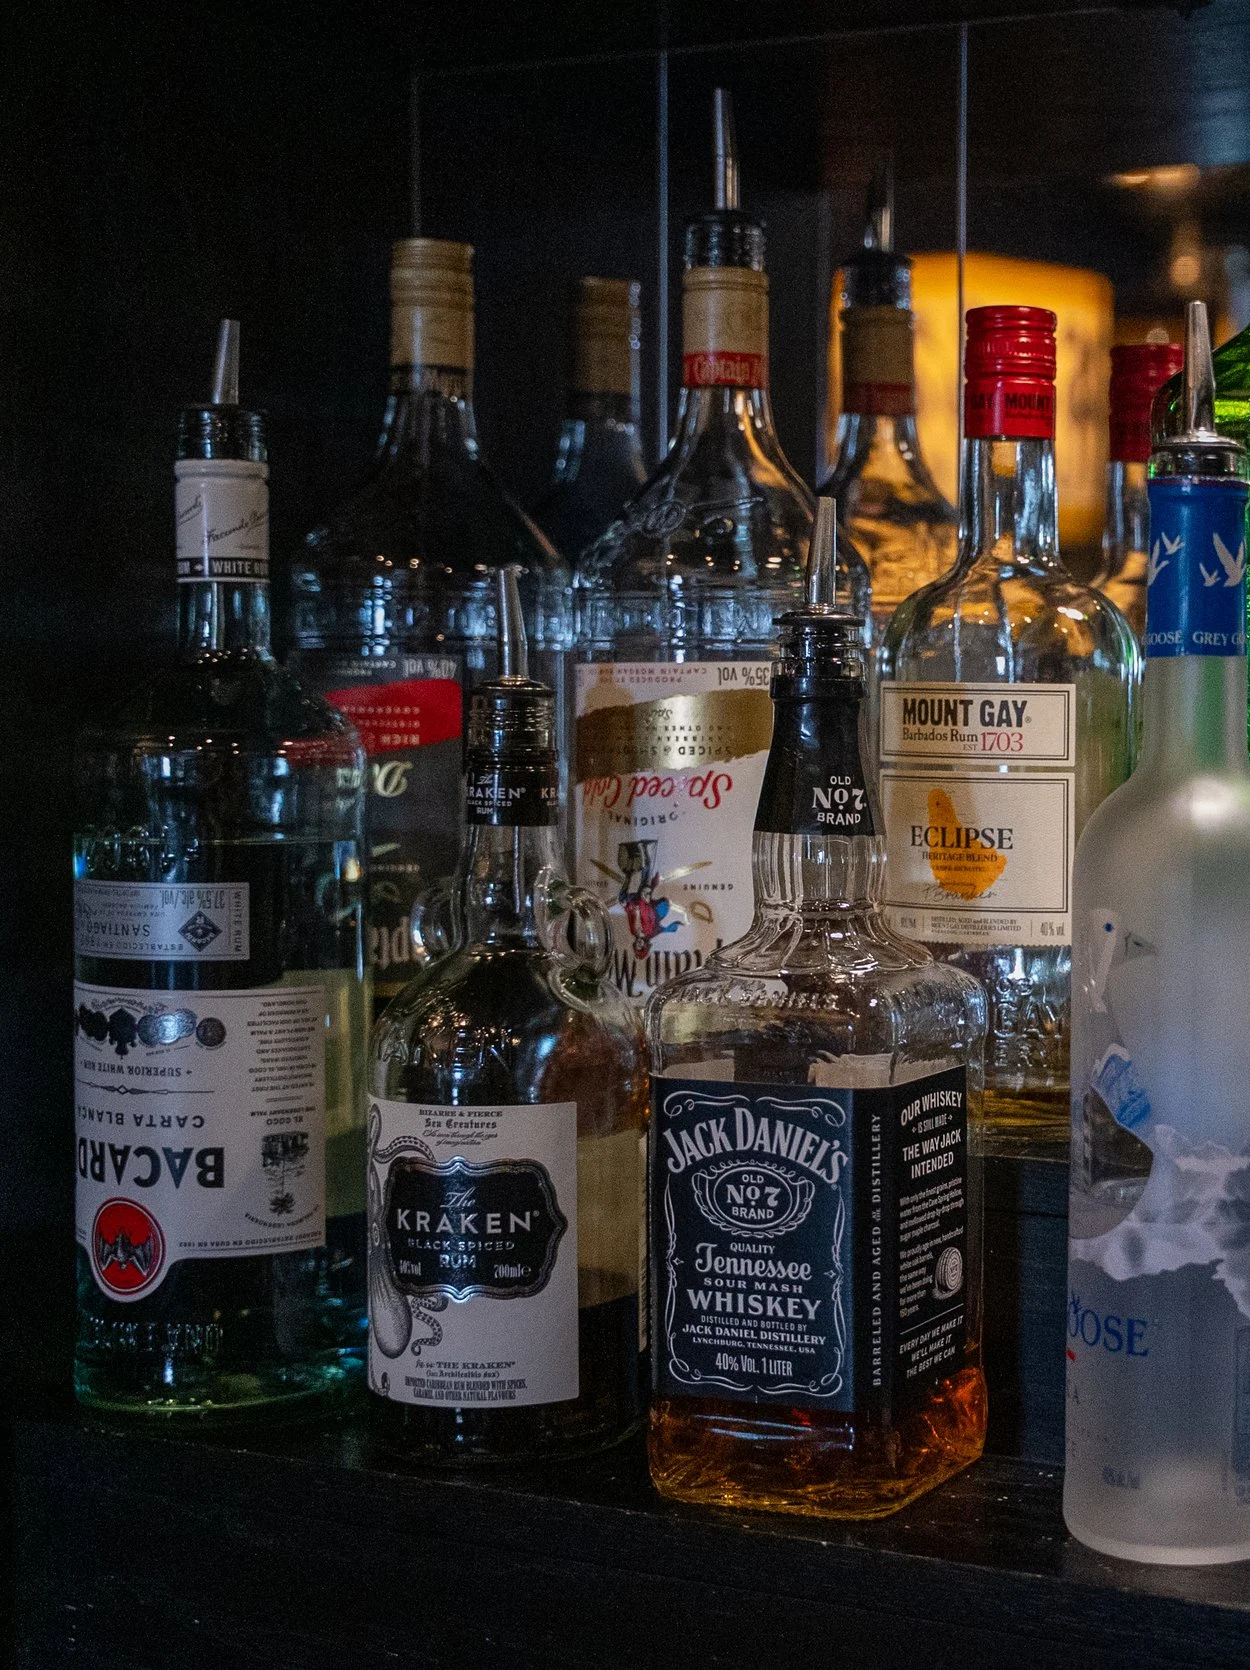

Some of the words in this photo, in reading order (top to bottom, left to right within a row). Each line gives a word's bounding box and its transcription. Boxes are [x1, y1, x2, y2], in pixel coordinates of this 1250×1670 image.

[211, 560, 251, 574] WHITE
[1192, 631, 1229, 647] GREY
[717, 667, 738, 686] vol
[742, 667, 770, 686] 35%
[902, 698, 973, 727] MOUNT
[980, 699, 1028, 728] GAY
[902, 727, 948, 742] Barbados
[950, 728, 978, 742] Rum
[980, 731, 1024, 752] 1703
[626, 770, 733, 810] Spiced
[830, 775, 851, 786] OLD
[468, 786, 520, 799] RAKEN
[476, 807, 493, 815] RUM
[817, 812, 861, 826] BRAND
[910, 825, 1014, 850] ECLIPSE
[683, 883, 734, 891] GENUINE
[97, 1061, 125, 1075] WHITE
[128, 1065, 182, 1077] SUPERIOR
[77, 1106, 124, 1126] BLANC
[133, 1113, 205, 1128] CARTA
[419, 1108, 457, 1117] BIZARRE
[467, 1110, 503, 1118] FIERCE
[900, 1099, 921, 1126] OUR
[921, 1090, 962, 1112] WHISKEY
[266, 1117, 291, 1126] COCO
[446, 1118, 497, 1129] Creatures
[663, 1117, 734, 1174] JACK
[733, 1107, 849, 1184] DANIEL'S
[902, 1143, 920, 1162] THE
[921, 1136, 940, 1155] WAY
[940, 1128, 961, 1149] JACK
[78, 1137, 225, 1189] BACARD
[871, 1114, 881, 1203] DISTILLERY
[911, 1151, 954, 1179] INTENDED
[742, 1173, 764, 1183] OLD
[440, 1186, 477, 1208] The
[397, 1208, 531, 1234] KRAKEN
[731, 1206, 774, 1220] BRAND
[407, 1238, 451, 1251] BLACK
[458, 1241, 515, 1251] SPICED
[730, 1242, 776, 1254] QUALITY
[871, 1225, 882, 1266] AGED
[439, 1254, 477, 1268] RUM
[695, 1243, 812, 1281] Tennessee
[703, 1277, 748, 1289] SOUR
[754, 1281, 803, 1293] MASH
[871, 1271, 882, 1301] AND
[686, 1289, 822, 1320] WHISKEY
[700, 1315, 740, 1326] DISTILLED
[741, 1318, 758, 1328] AND
[760, 1320, 795, 1331] BOTTLED
[797, 1323, 808, 1332] BY
[1068, 1297, 1149, 1357] OOSE
[682, 1324, 712, 1335] JACK
[715, 1326, 758, 1339] DANIEL
[760, 1331, 826, 1345] DISTILLERY
[899, 1336, 919, 1355] EVERY
[919, 1330, 931, 1346] DAY
[931, 1326, 940, 1339] WE
[940, 1319, 957, 1336] MAKE
[957, 1314, 964, 1327] IT
[928, 1337, 945, 1354] MAKE
[945, 1333, 953, 1346] IT
[692, 1337, 746, 1348] LYNCHBURG,
[746, 1341, 797, 1353] TENNESSEE,
[798, 1346, 816, 1354] USA
[871, 1306, 882, 1386] BARRELED
[436, 1361, 460, 1369] THE
[715, 1352, 739, 1371] 40%
[740, 1355, 760, 1374] VOL.
[760, 1357, 767, 1374] 1
[768, 1359, 793, 1377] LITER
[906, 1366, 918, 1379] THE
[918, 1356, 933, 1374] BEST
[933, 1352, 943, 1365] WE
[943, 1345, 956, 1359] CAN
